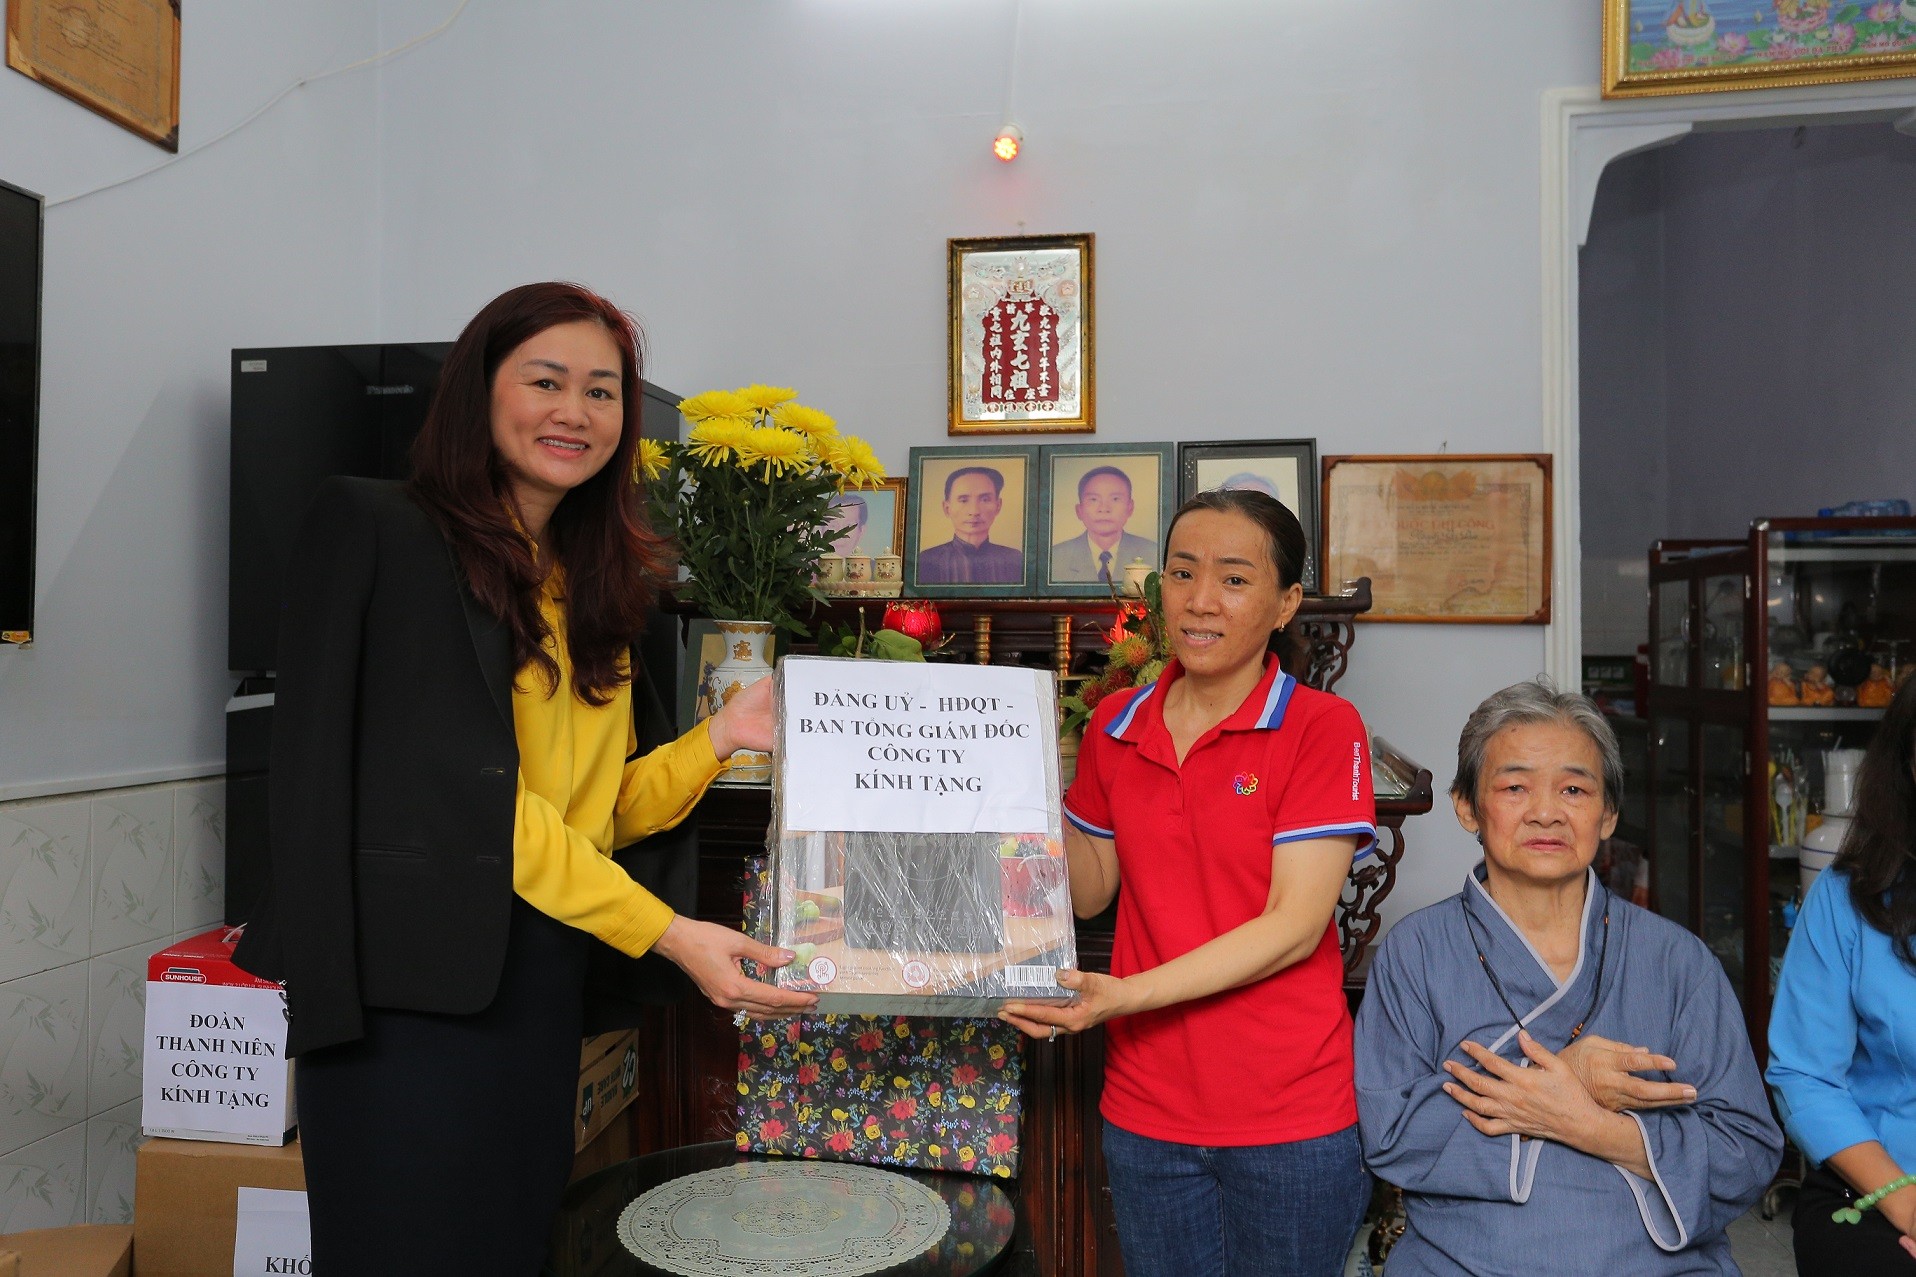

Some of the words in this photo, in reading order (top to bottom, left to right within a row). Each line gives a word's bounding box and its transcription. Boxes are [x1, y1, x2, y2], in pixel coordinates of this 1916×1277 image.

[813, 689, 877, 709] ĐẢNG
[884, 691, 914, 712] UỶ
[939, 696, 1001, 714] HĐQT
[799, 718, 844, 734] BAN
[850, 717, 912, 739] TỔNG
[918, 721, 977, 740] GIÁM
[984, 719, 1030, 739] ĐỐC
[867, 743, 931, 764] CÔNG
[936, 749, 966, 764] TY
[855, 769, 914, 790] KÍNH
[919, 773, 982, 796] TẶNG
[165, 974, 204, 982] SUNHOUSE
[189, 1011, 245, 1031] ĐOÀN
[156, 1035, 225, 1053] THANH
[230, 1038, 276, 1057] NIÊN
[171, 1059, 228, 1079] CÔNG
[233, 1066, 259, 1081] TY
[160, 1085, 210, 1104] KÍNH
[216, 1089, 269, 1110] TẶNG
[582, 1097, 592, 1116] UP
